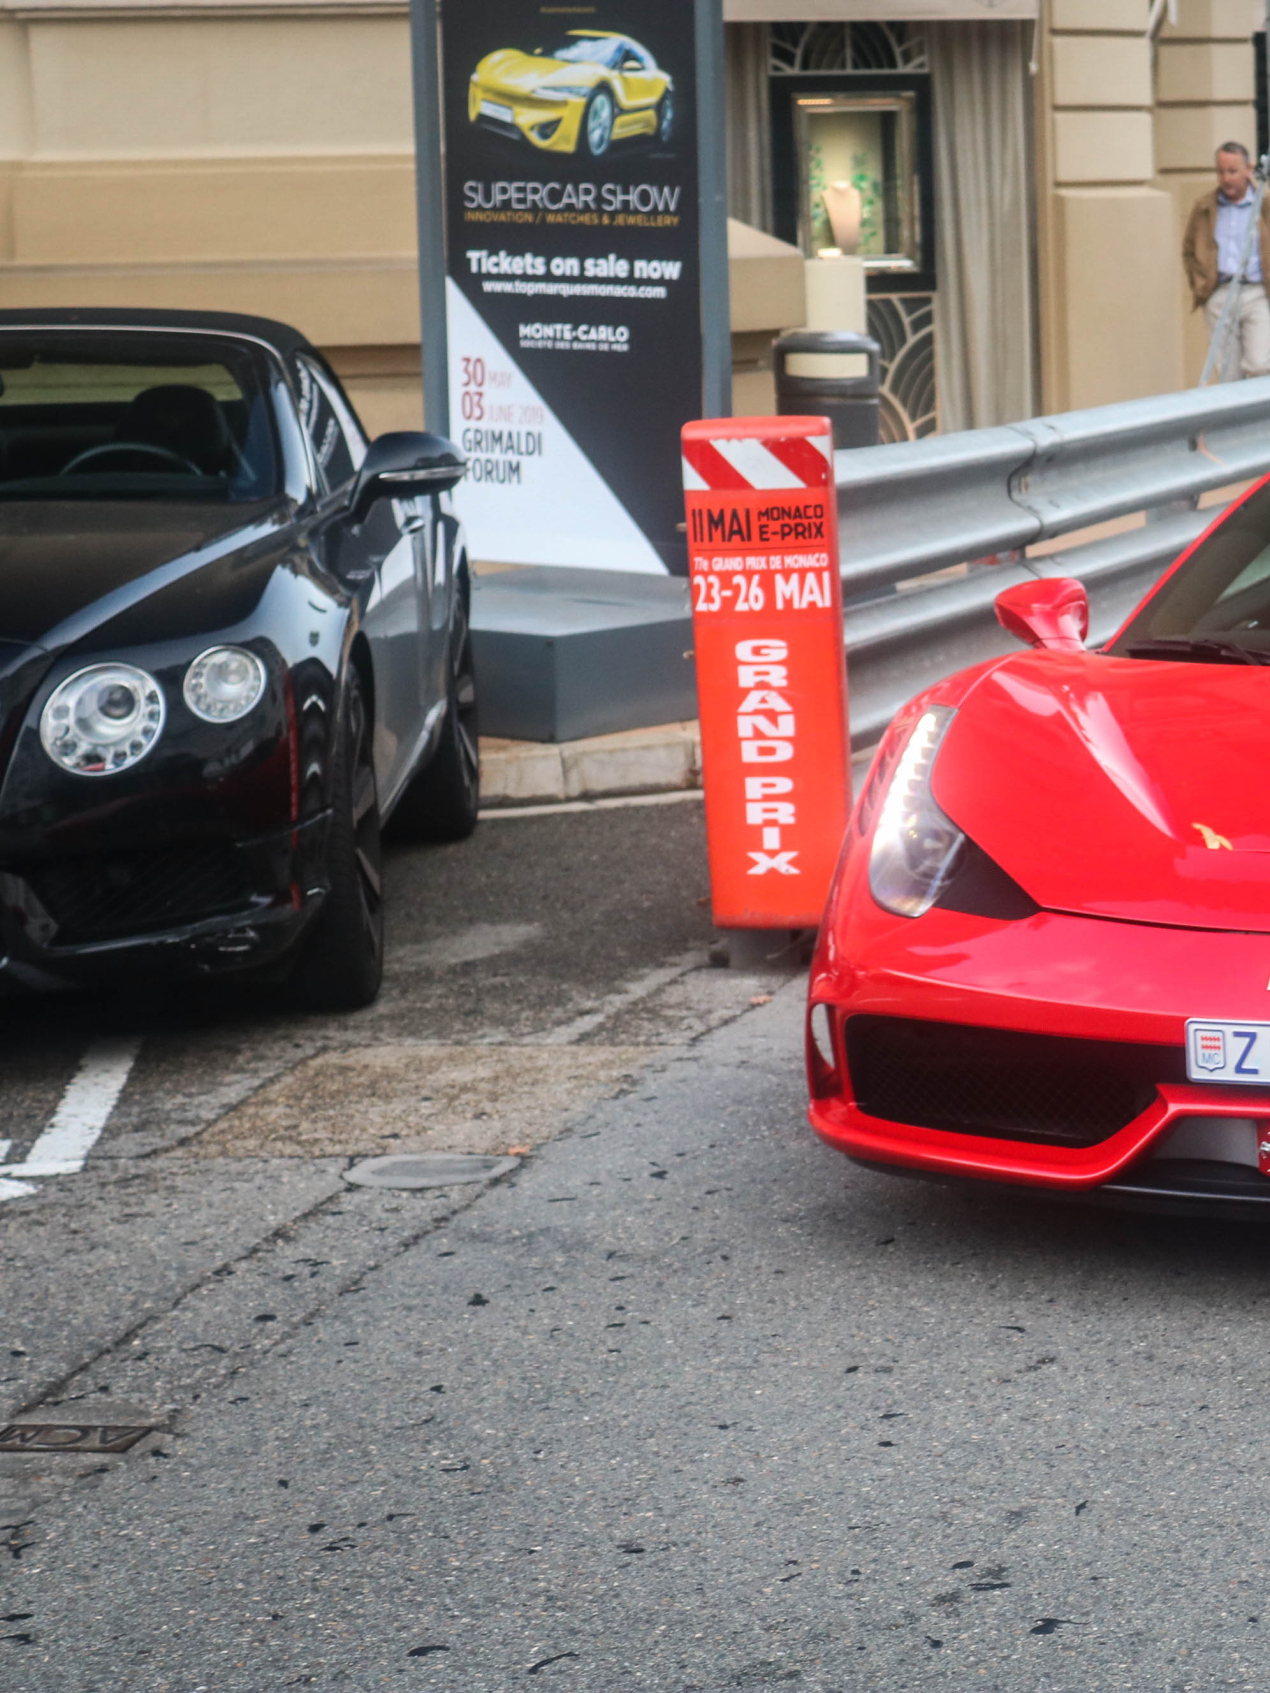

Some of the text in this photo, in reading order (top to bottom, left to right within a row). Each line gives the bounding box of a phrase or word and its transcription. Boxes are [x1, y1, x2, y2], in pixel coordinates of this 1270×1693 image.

[463, 181, 681, 212] SUPERCAR SHOW
[464, 211, 533, 224] INNOVATION
[545, 212, 598, 225] WATCHES
[602, 213, 610, 226] &
[612, 213, 680, 227] JEWELLERY
[466, 250, 682, 280] Tickets on sale now
[482, 279, 667, 299] www.topmarquesmonaco.com
[519, 322, 630, 342] MONTE-CARLO
[461, 357, 512, 387] 30 MAY
[461, 391, 544, 426] 03 JUNE 2019
[462, 428, 543, 456] GRIMALDI
[464, 457, 521, 484] FORUM
[757, 504, 824, 522] MONACO
[759, 521, 824, 542] E-PRIX
[711, 556, 744, 572] GRAND
[746, 555, 767, 571] PRIX
[769, 556, 782, 570] DE
[784, 552, 829, 570] MONACO
[693, 570, 832, 612] 23-26 MAI
[735, 639, 796, 763] GRAND
[744, 777, 801, 875] PRIX
[1201, 1052, 1222, 1065] MC
